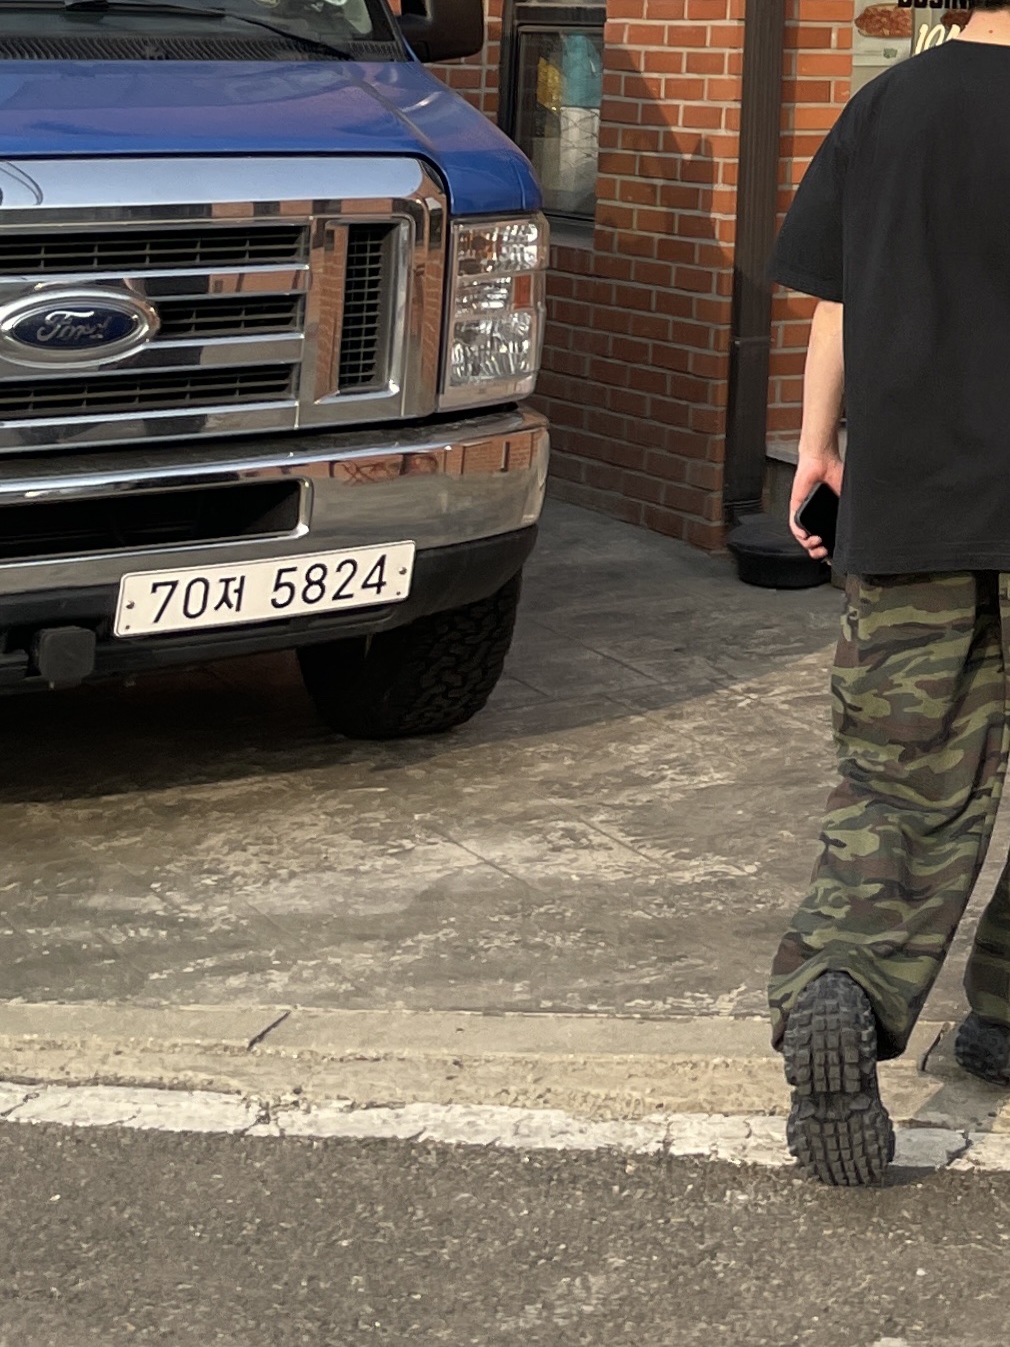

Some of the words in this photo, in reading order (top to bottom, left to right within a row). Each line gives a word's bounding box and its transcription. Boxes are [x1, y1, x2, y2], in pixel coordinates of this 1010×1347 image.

[36, 310, 112, 342] Ford
[150, 574, 246, 624] 70저
[270, 554, 388, 610] 5824
